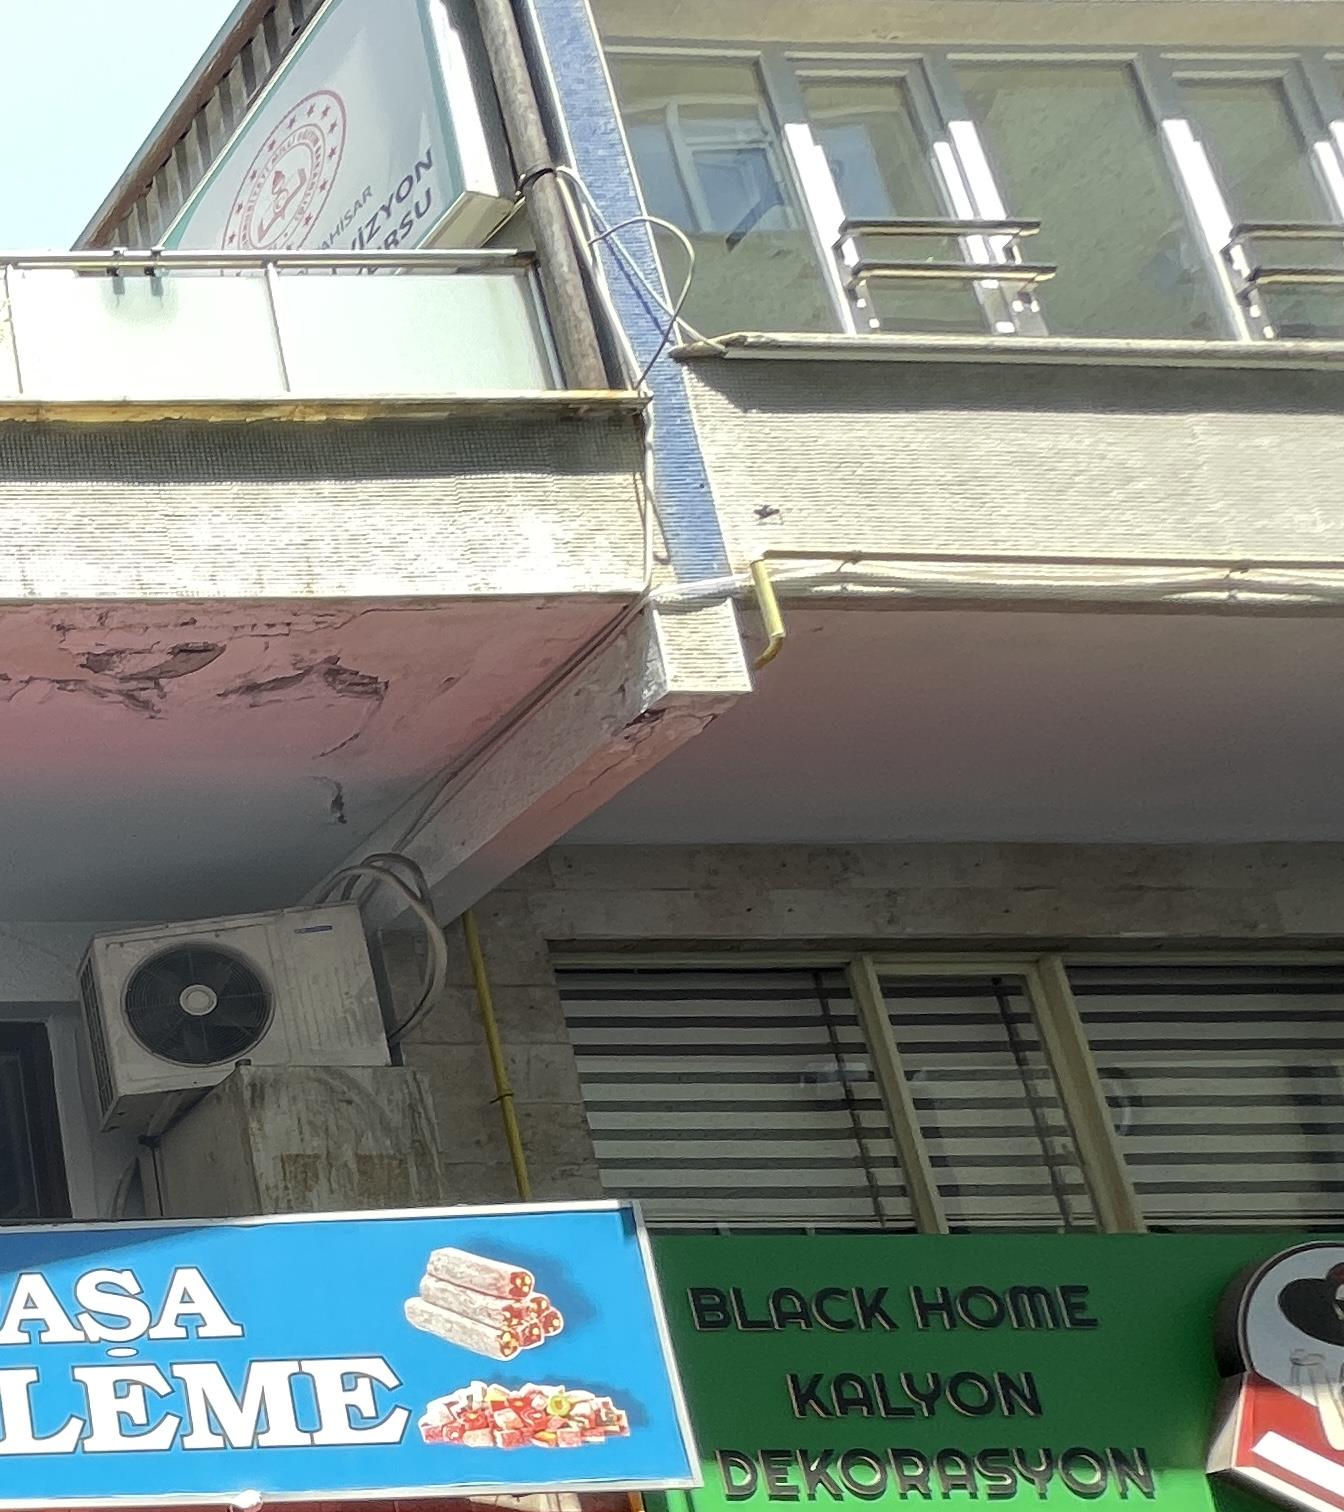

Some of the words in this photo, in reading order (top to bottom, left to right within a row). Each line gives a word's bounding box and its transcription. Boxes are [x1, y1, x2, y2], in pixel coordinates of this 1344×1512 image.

[686, 1285, 900, 1332] BLACK
[910, 1284, 1100, 1331] HOME
[785, 1370, 1045, 1420] KALYON
[714, 1446, 1158, 1503] DEKORASYON
